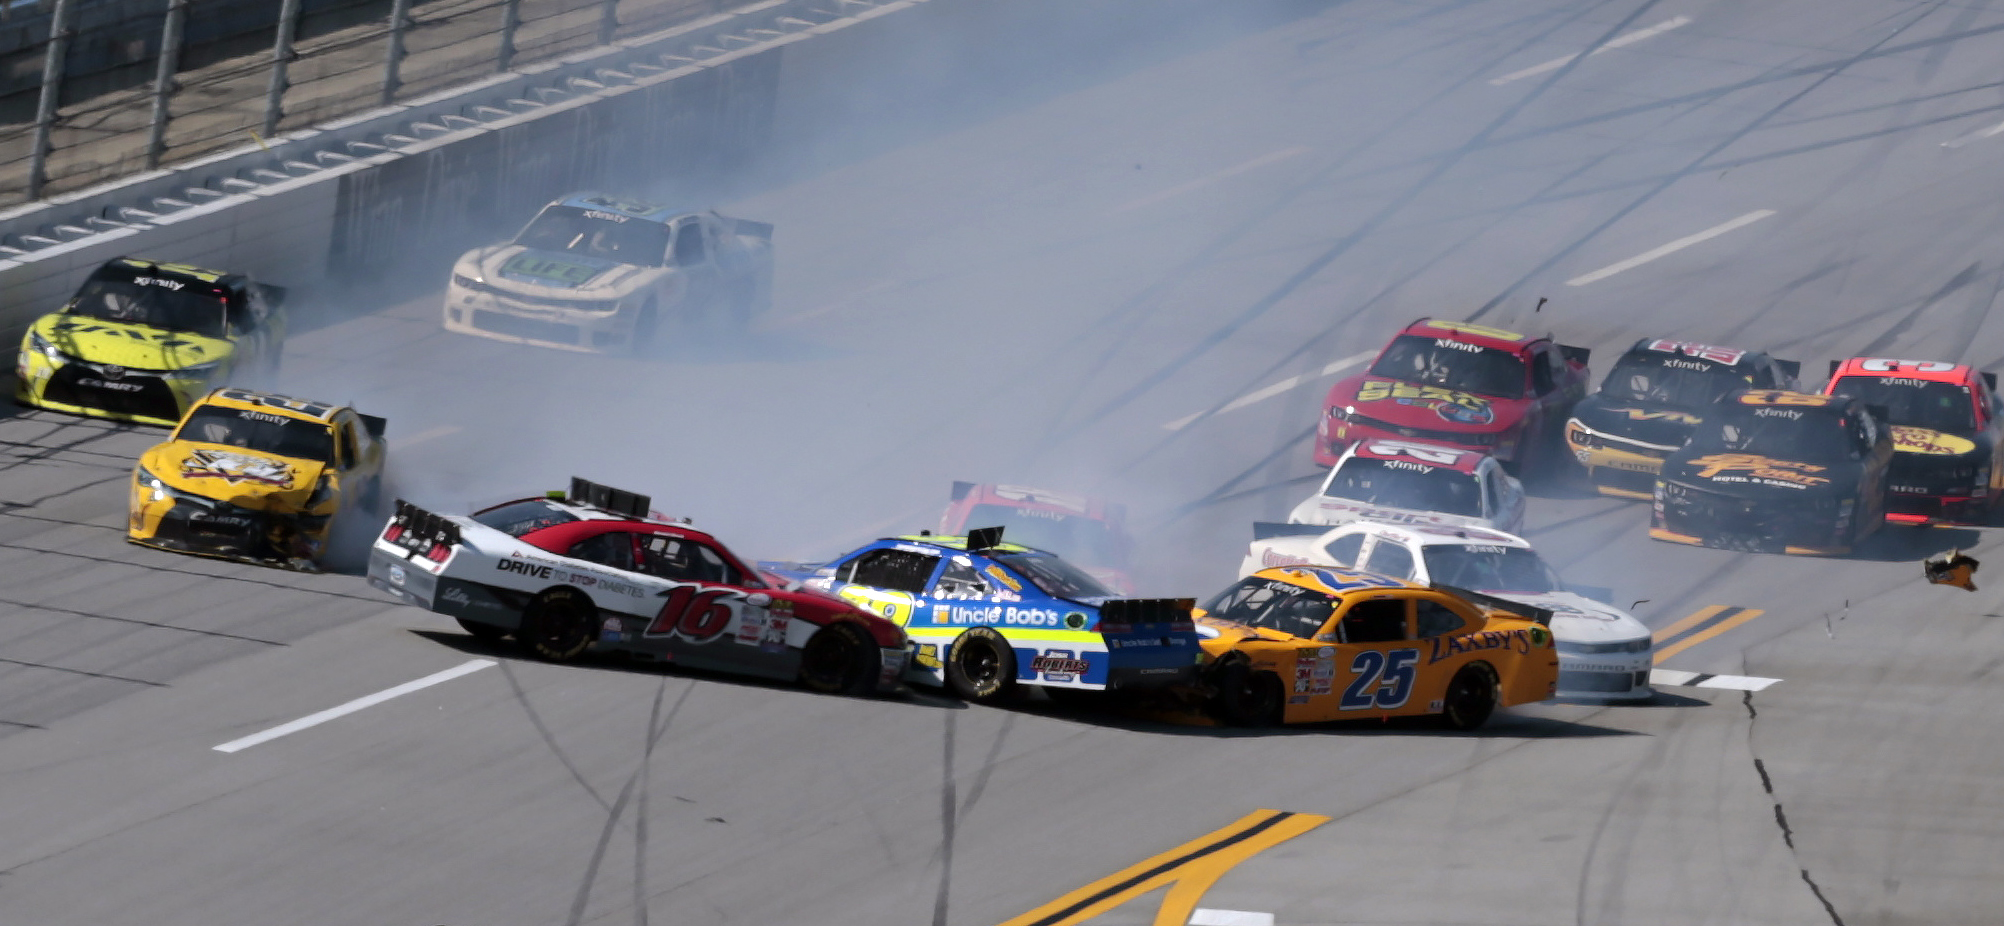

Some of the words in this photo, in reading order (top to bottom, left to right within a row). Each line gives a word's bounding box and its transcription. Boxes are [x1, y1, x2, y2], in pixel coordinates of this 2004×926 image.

[1663, 359, 1711, 372] xfinity
[1879, 377, 1928, 388] xfinity
[1754, 408, 1804, 420] xfinity
[1383, 459, 1434, 474] xfinity
[497, 558, 554, 579] DRIVE
[553, 569, 569, 582] TO
[569, 573, 597, 587] STOP
[597, 579, 645, 598] DIABETES
[644, 583, 748, 644] 16
[952, 606, 1002, 624] Uncle
[1005, 606, 1059, 626] Bob's
[1339, 648, 1420, 711] 25
